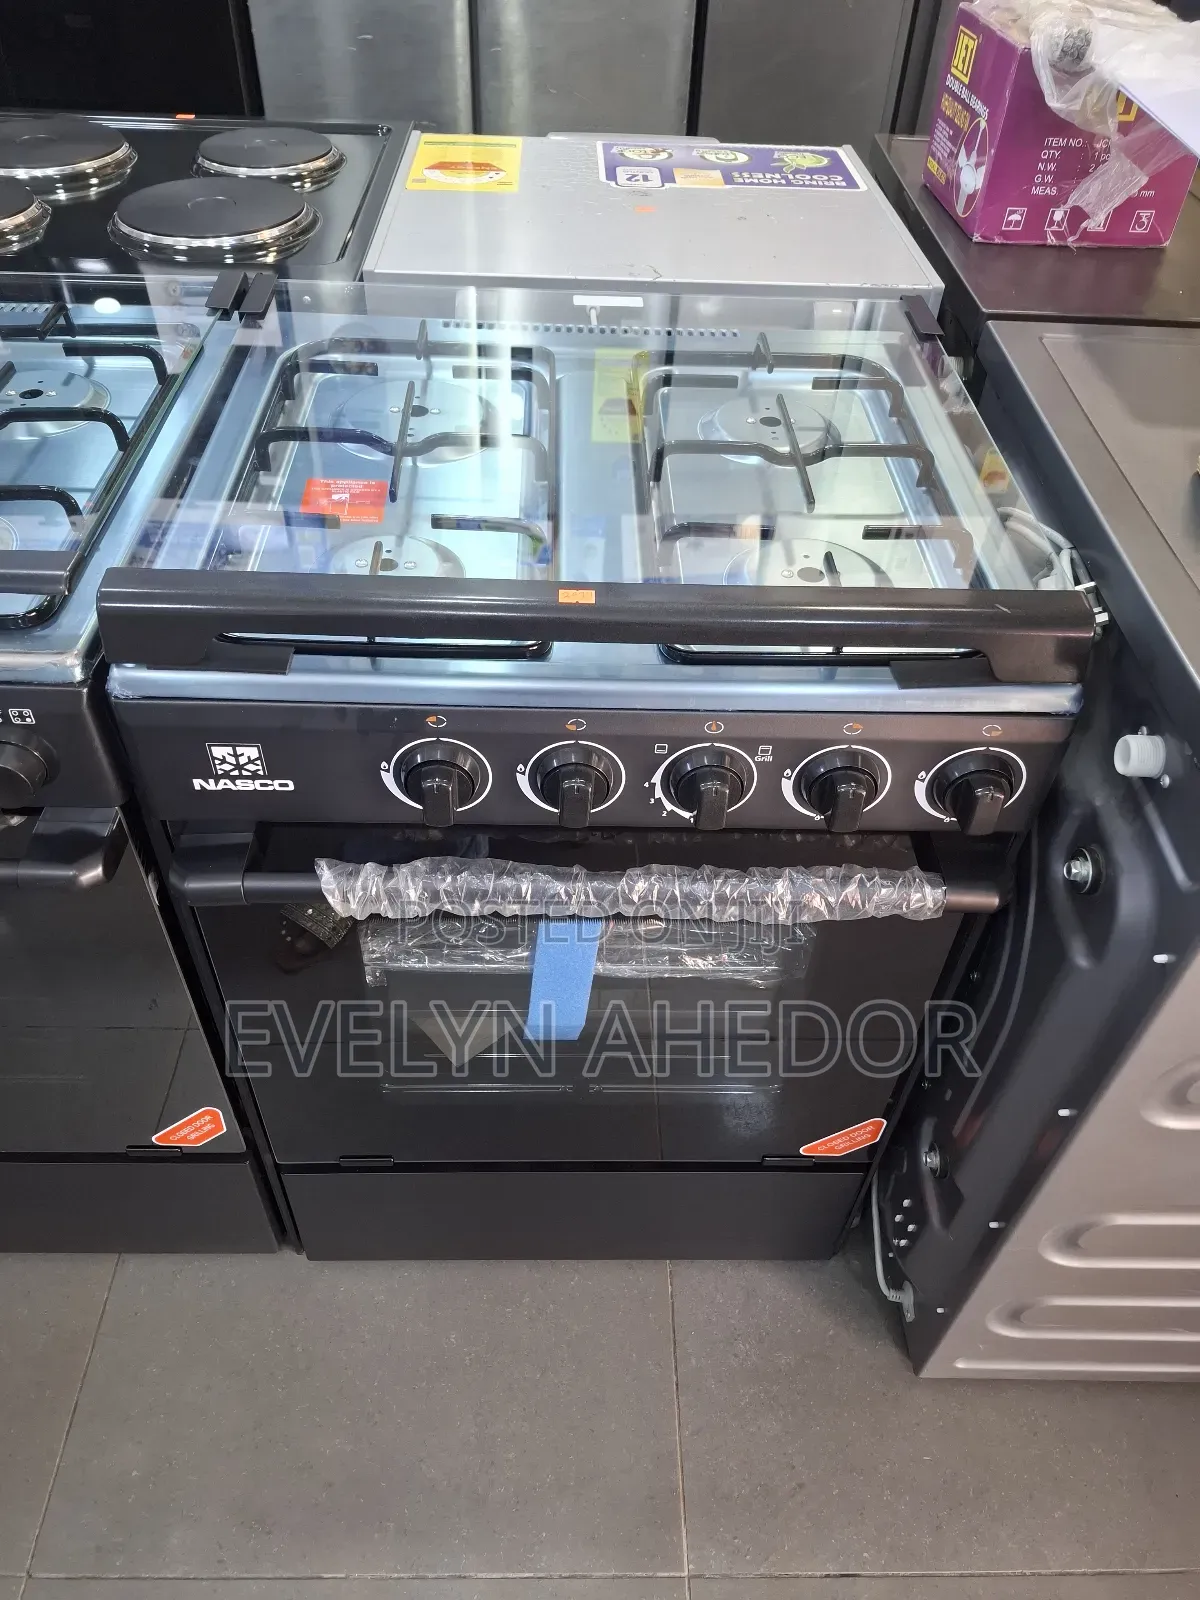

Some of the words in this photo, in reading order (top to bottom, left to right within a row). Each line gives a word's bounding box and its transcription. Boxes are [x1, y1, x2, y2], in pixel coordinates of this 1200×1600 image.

[953, 31, 976, 77] JET
[946, 74, 962, 96] DOUBLE
[1044, 137, 1067, 147] ITEM
[1041, 150, 1061, 159] QTY.
[1037, 162, 1057, 171] N.W.
[625, 173, 653, 183] 12
[731, 172, 844, 181] COOLNESS
[733, 177, 787, 185] HOME
[1034, 174, 1054, 183] G.W.
[791, 178, 847, 187] BRING
[1031, 186, 1058, 195] MEAS.
[192, 779, 295, 791] NASCO
[170, 1125, 195, 1140] CLOSED
[192, 1115, 213, 1128] DOOR
[818, 1136, 849, 1151] CLOSED
[849, 1125, 875, 1138] DOOR
